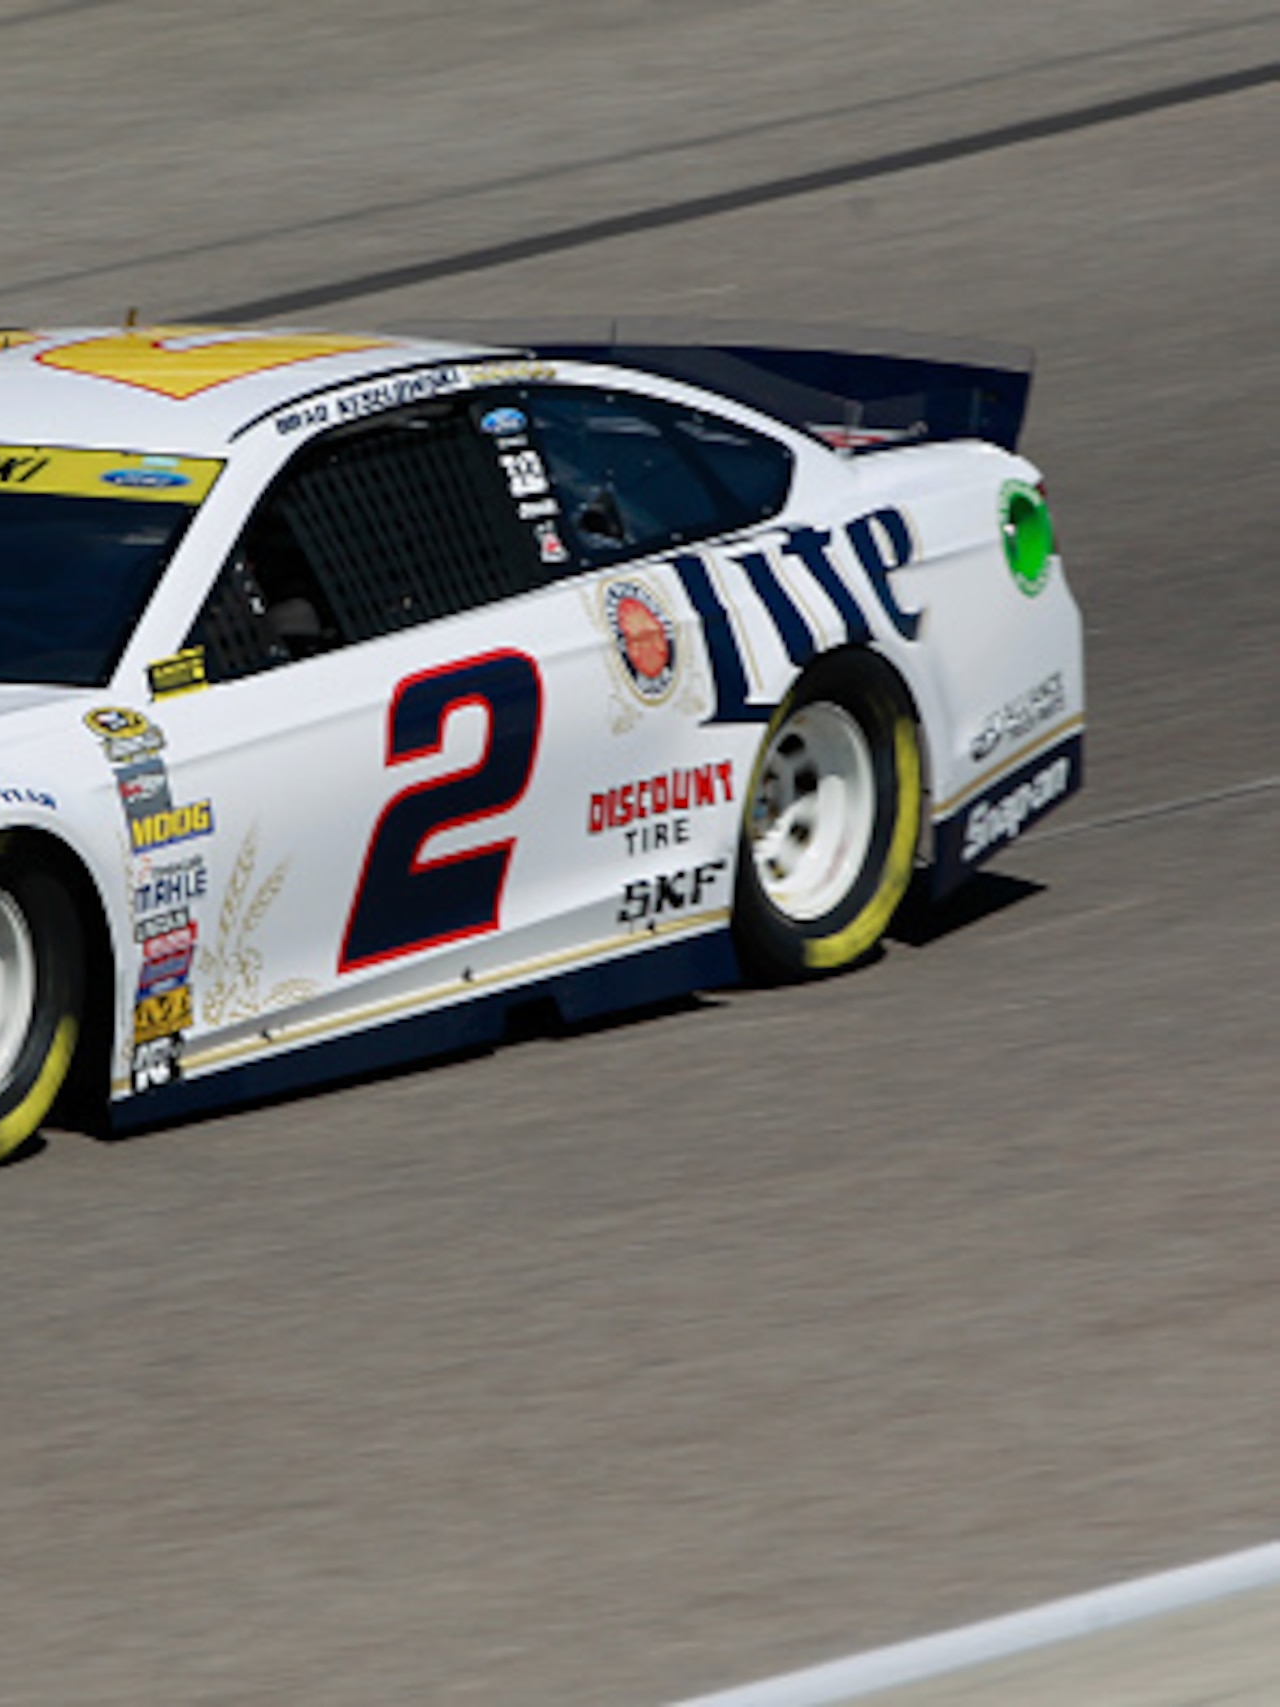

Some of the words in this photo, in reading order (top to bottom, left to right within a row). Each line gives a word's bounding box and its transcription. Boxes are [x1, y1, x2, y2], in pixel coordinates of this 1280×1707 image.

[665, 506, 926, 728] Lite
[131, 799, 212, 849] MOOG
[336, 645, 546, 976] 2
[586, 759, 735, 835] DISCOUNT
[624, 818, 691, 858] TIRE
[134, 867, 208, 914] MAHLE
[616, 861, 728, 926] SKF
